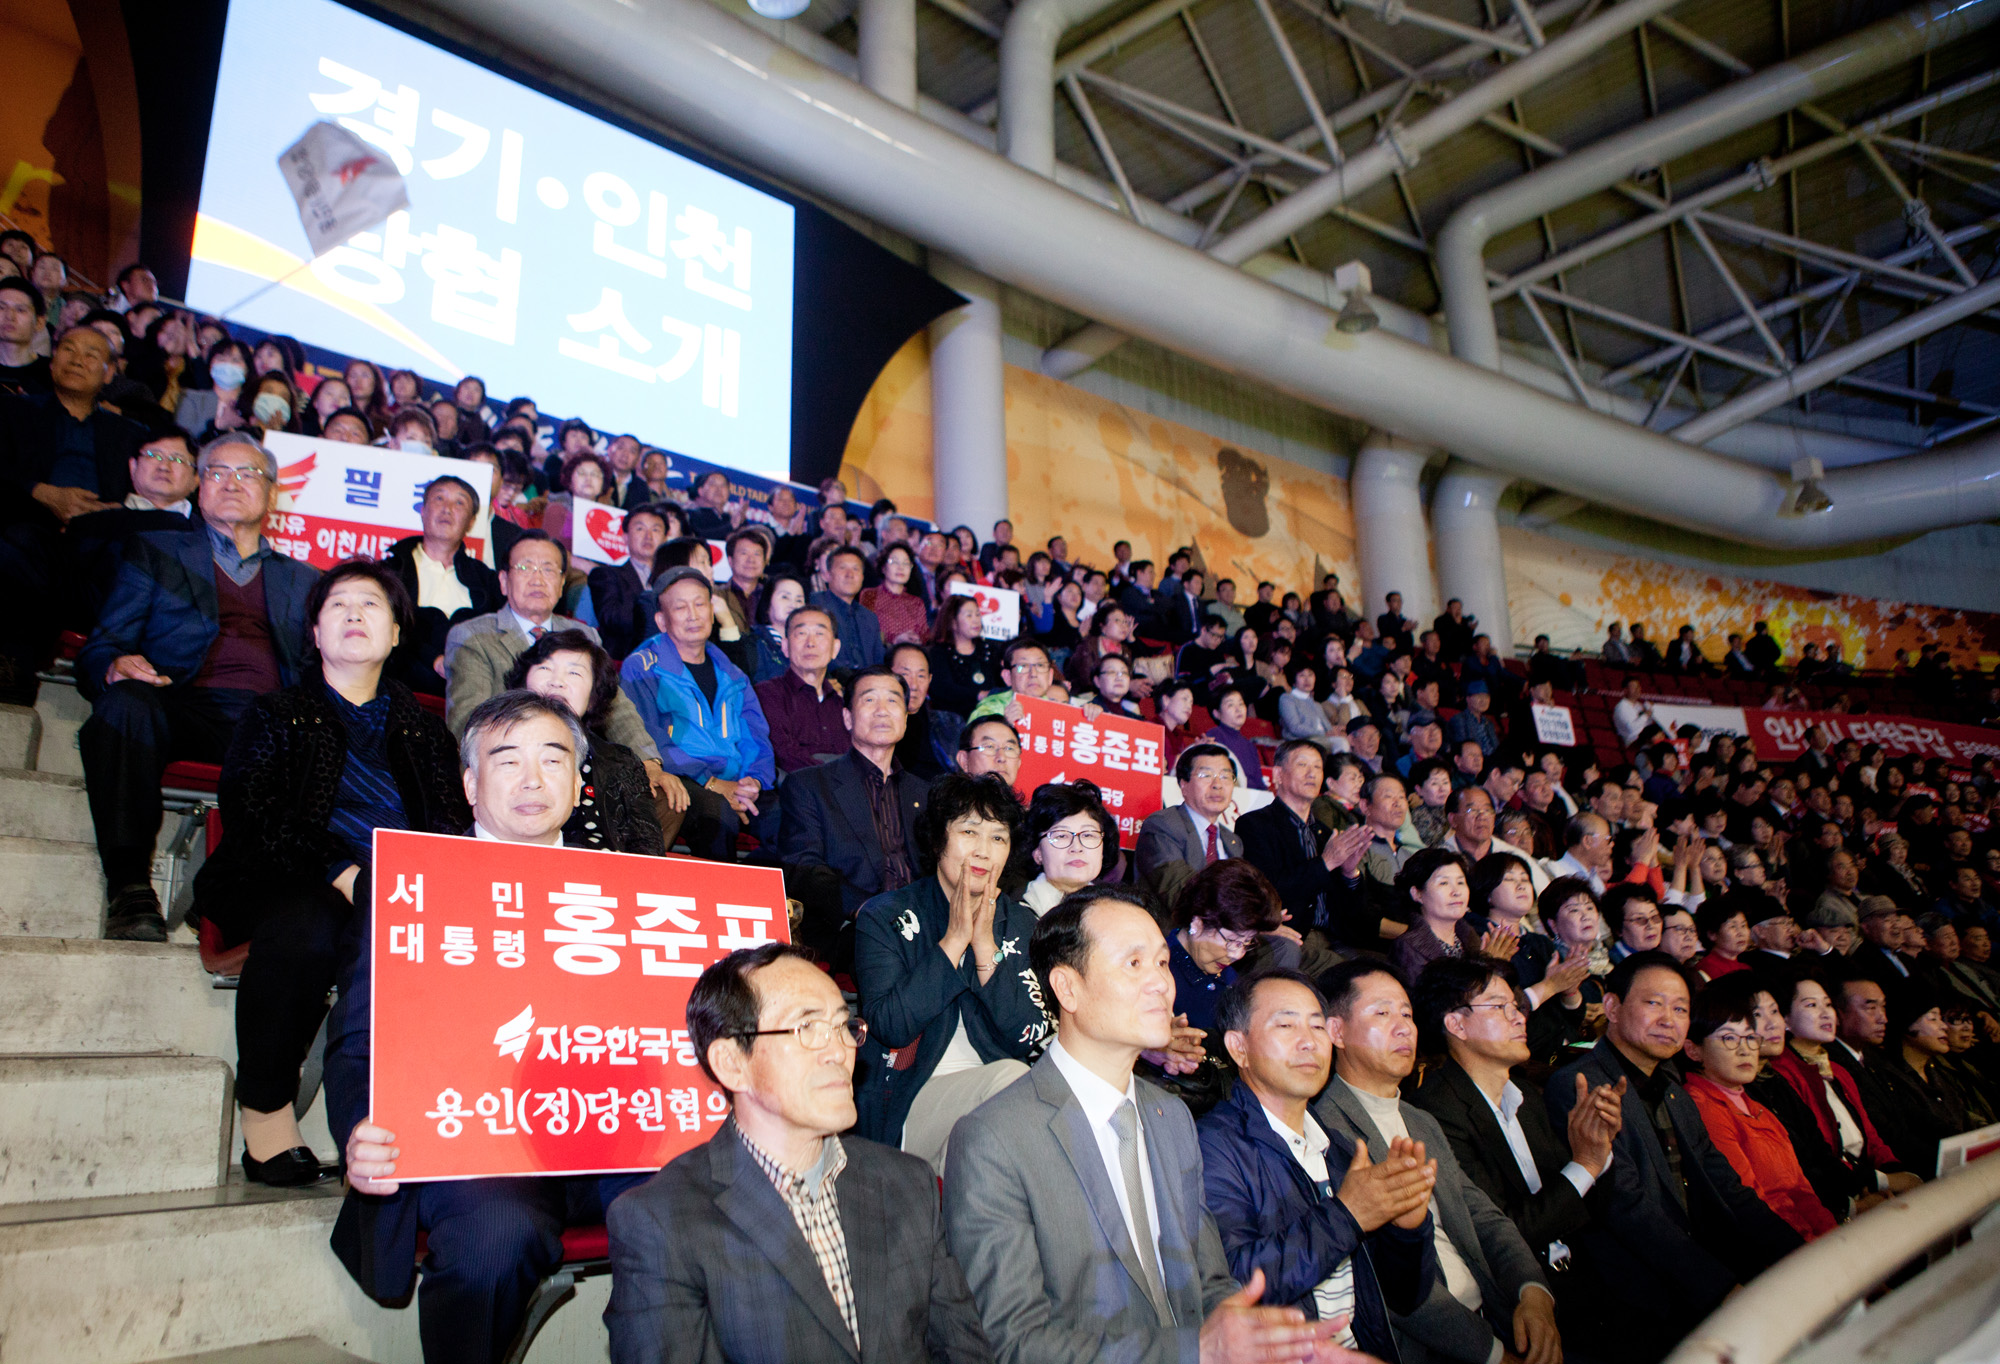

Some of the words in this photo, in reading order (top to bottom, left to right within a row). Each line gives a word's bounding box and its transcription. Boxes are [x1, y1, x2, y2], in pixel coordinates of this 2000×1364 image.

[558, 286, 741, 418] 소개
[1020, 733, 1065, 757] 대통령
[1069, 722, 1162, 775] 홍준표
[389, 923, 526, 969] 대통령
[536, 1025, 699, 1067] 자유한국당
